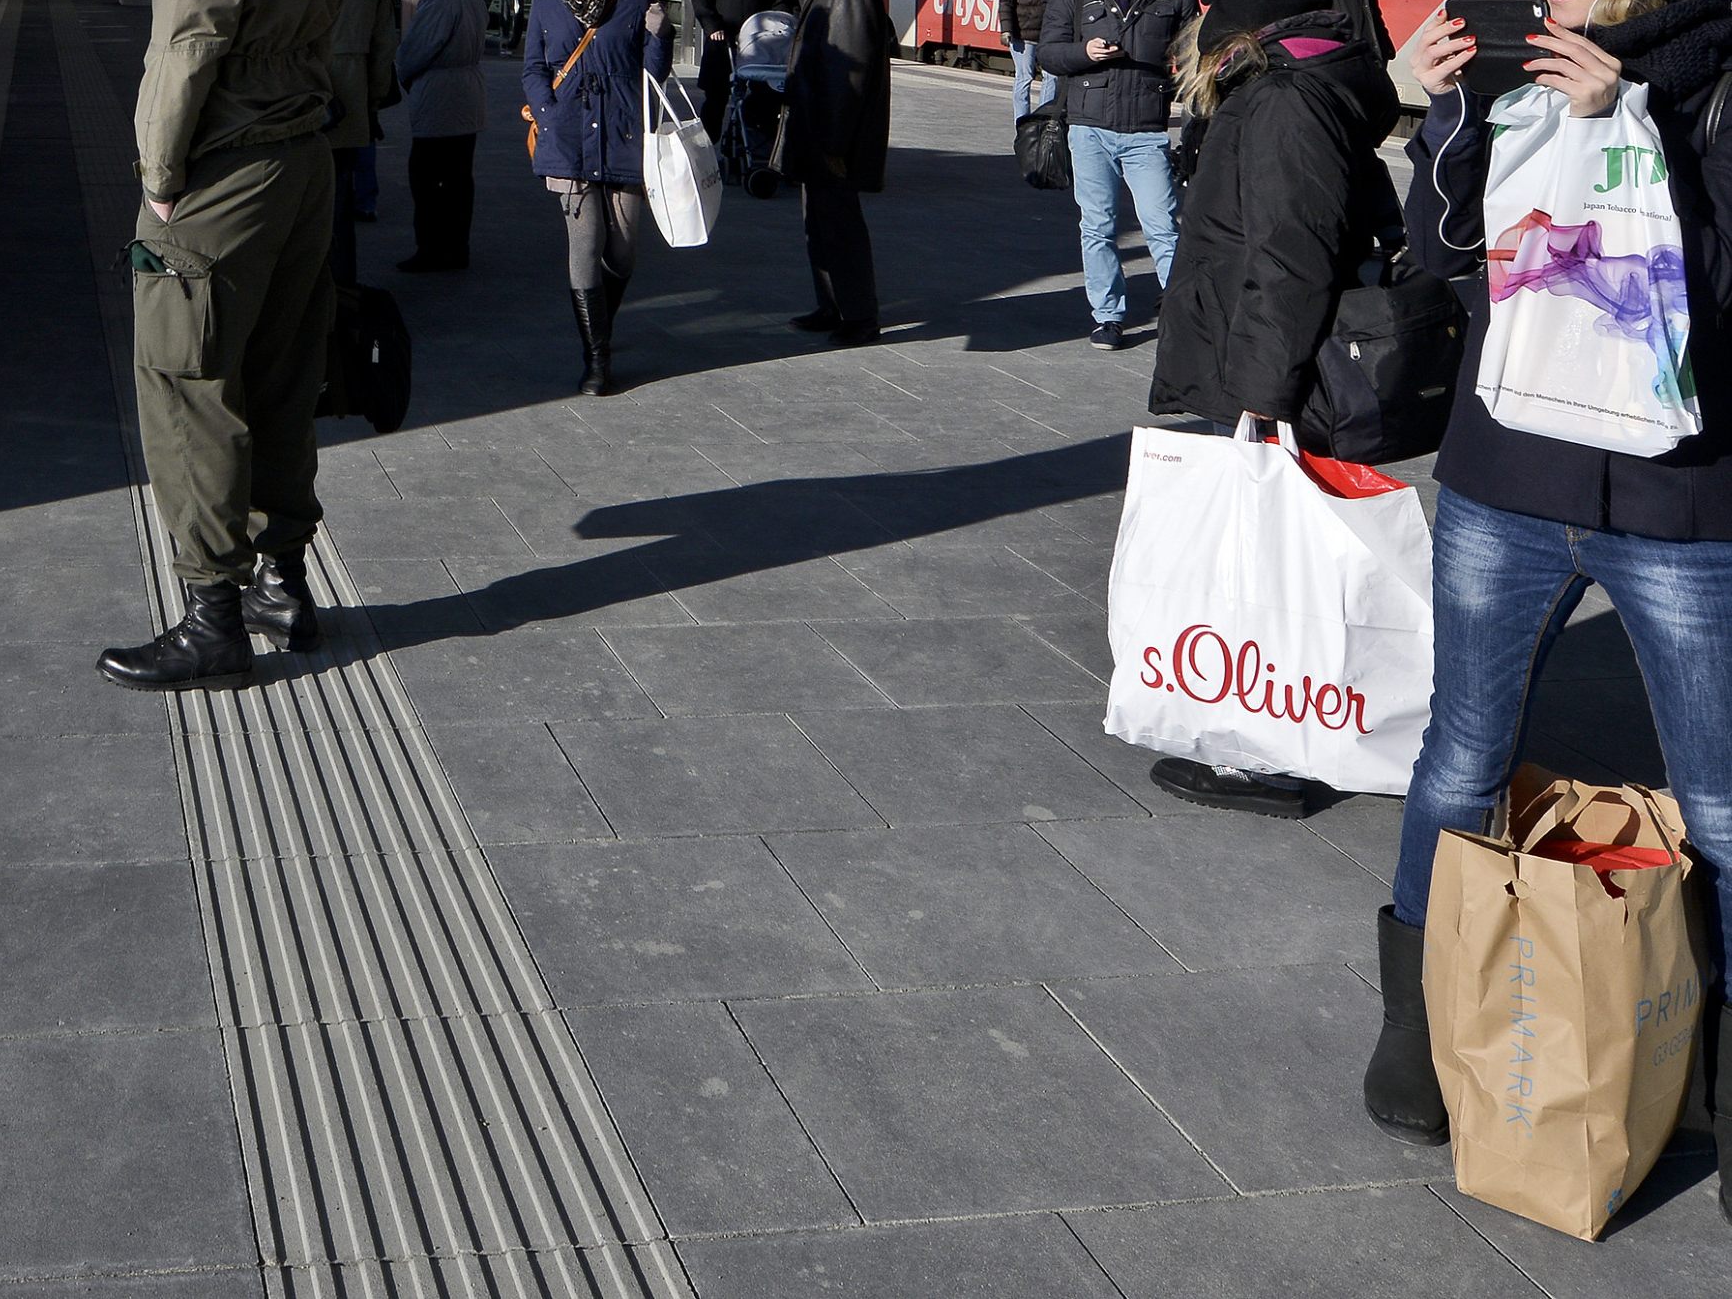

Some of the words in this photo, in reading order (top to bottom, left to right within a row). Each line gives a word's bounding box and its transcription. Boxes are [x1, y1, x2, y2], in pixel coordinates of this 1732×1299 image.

[1583, 202, 1606, 211] Japan
[1606, 203, 1637, 214] Tobacco
[1140, 624, 1374, 735] s.Oliver
[1505, 933, 1539, 1129] PRIMARK
